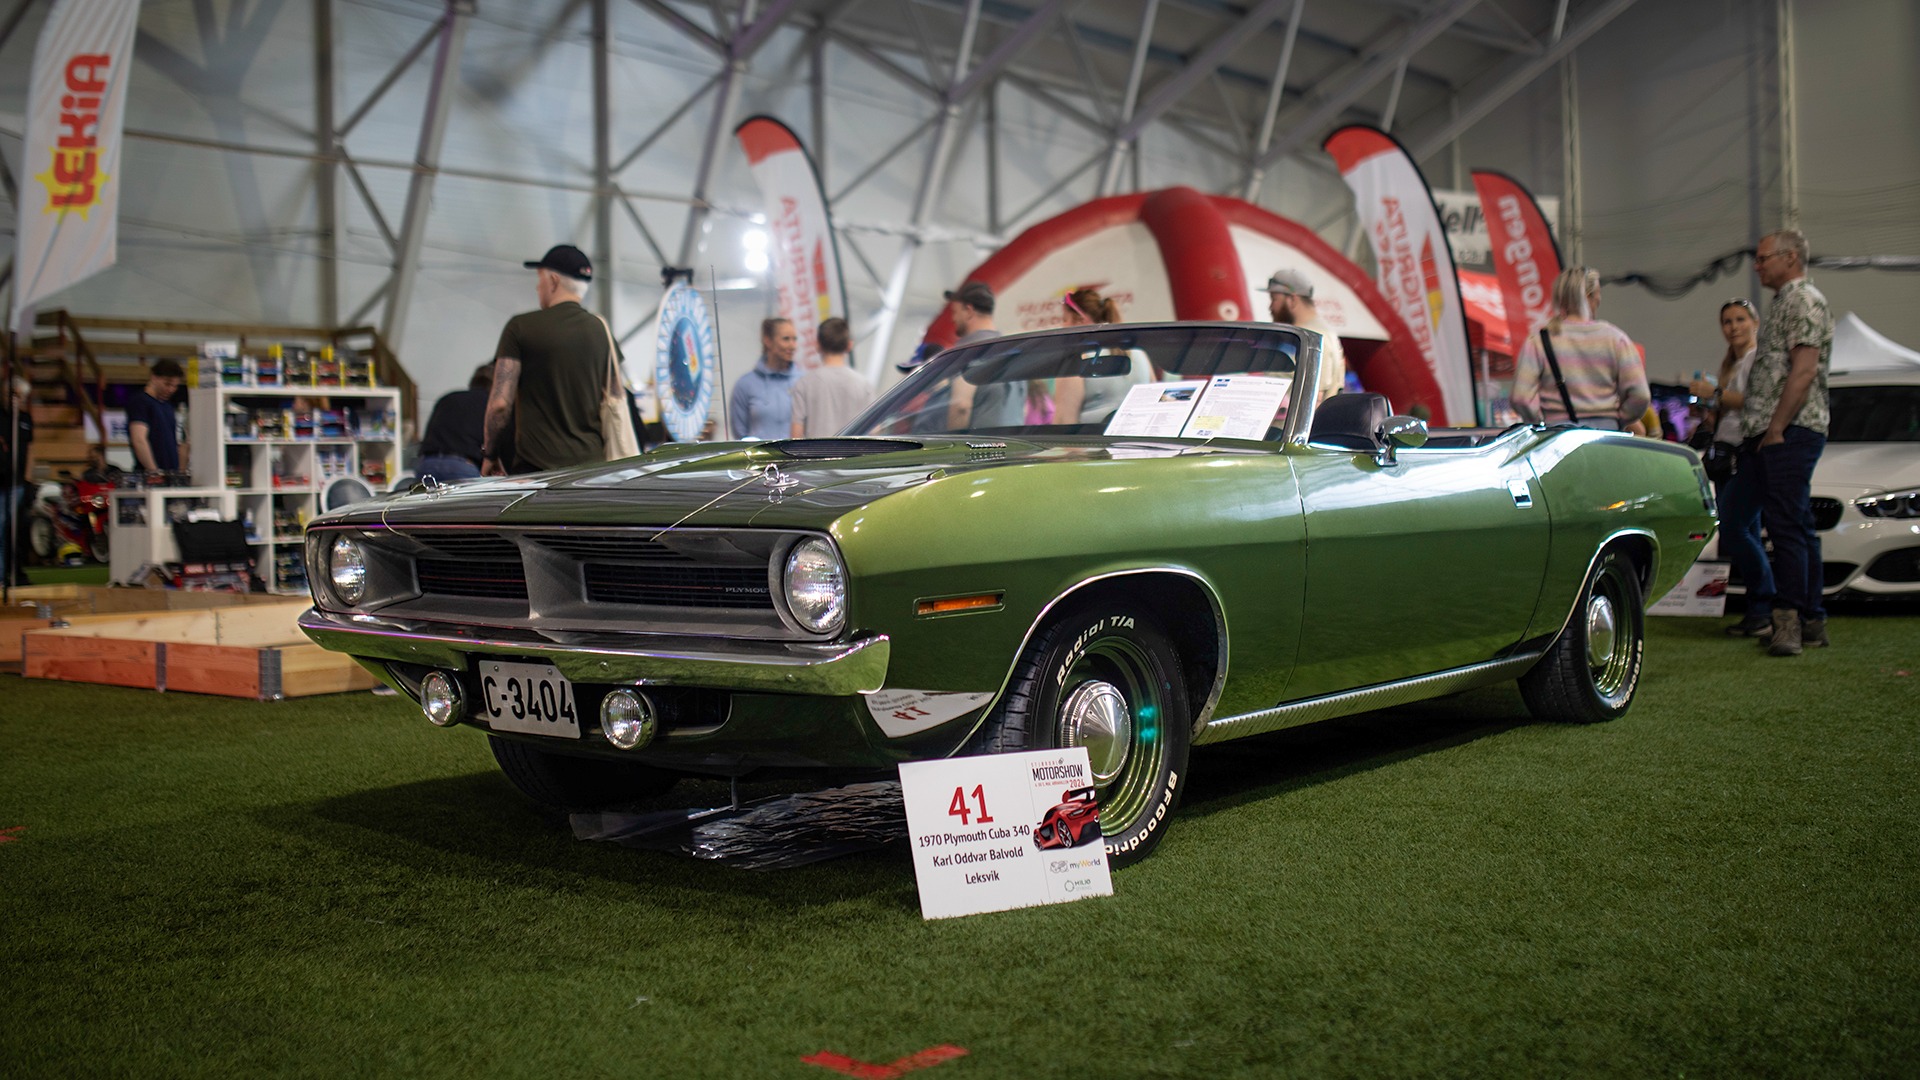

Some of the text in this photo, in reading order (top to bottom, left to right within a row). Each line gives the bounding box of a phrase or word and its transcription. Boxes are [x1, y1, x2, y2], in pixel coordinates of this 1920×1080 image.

[725, 586, 770, 594] PLYMOU
[1110, 615, 1135, 630] T/A
[483, 675, 576, 725] C-3404
[1032, 764, 1083, 781] MOTORSHOW
[1069, 779, 1086, 788] 2024
[948, 784, 994, 826] 41
[1103, 769, 1178, 856] BFGoodric
[918, 824, 1030, 848] 1970 Plymouth Cuba 340
[932, 846, 1024, 868] Karl Oddvar Balvold
[1069, 858, 1101, 870] myWorld
[965, 870, 1001, 885] Leksvik
